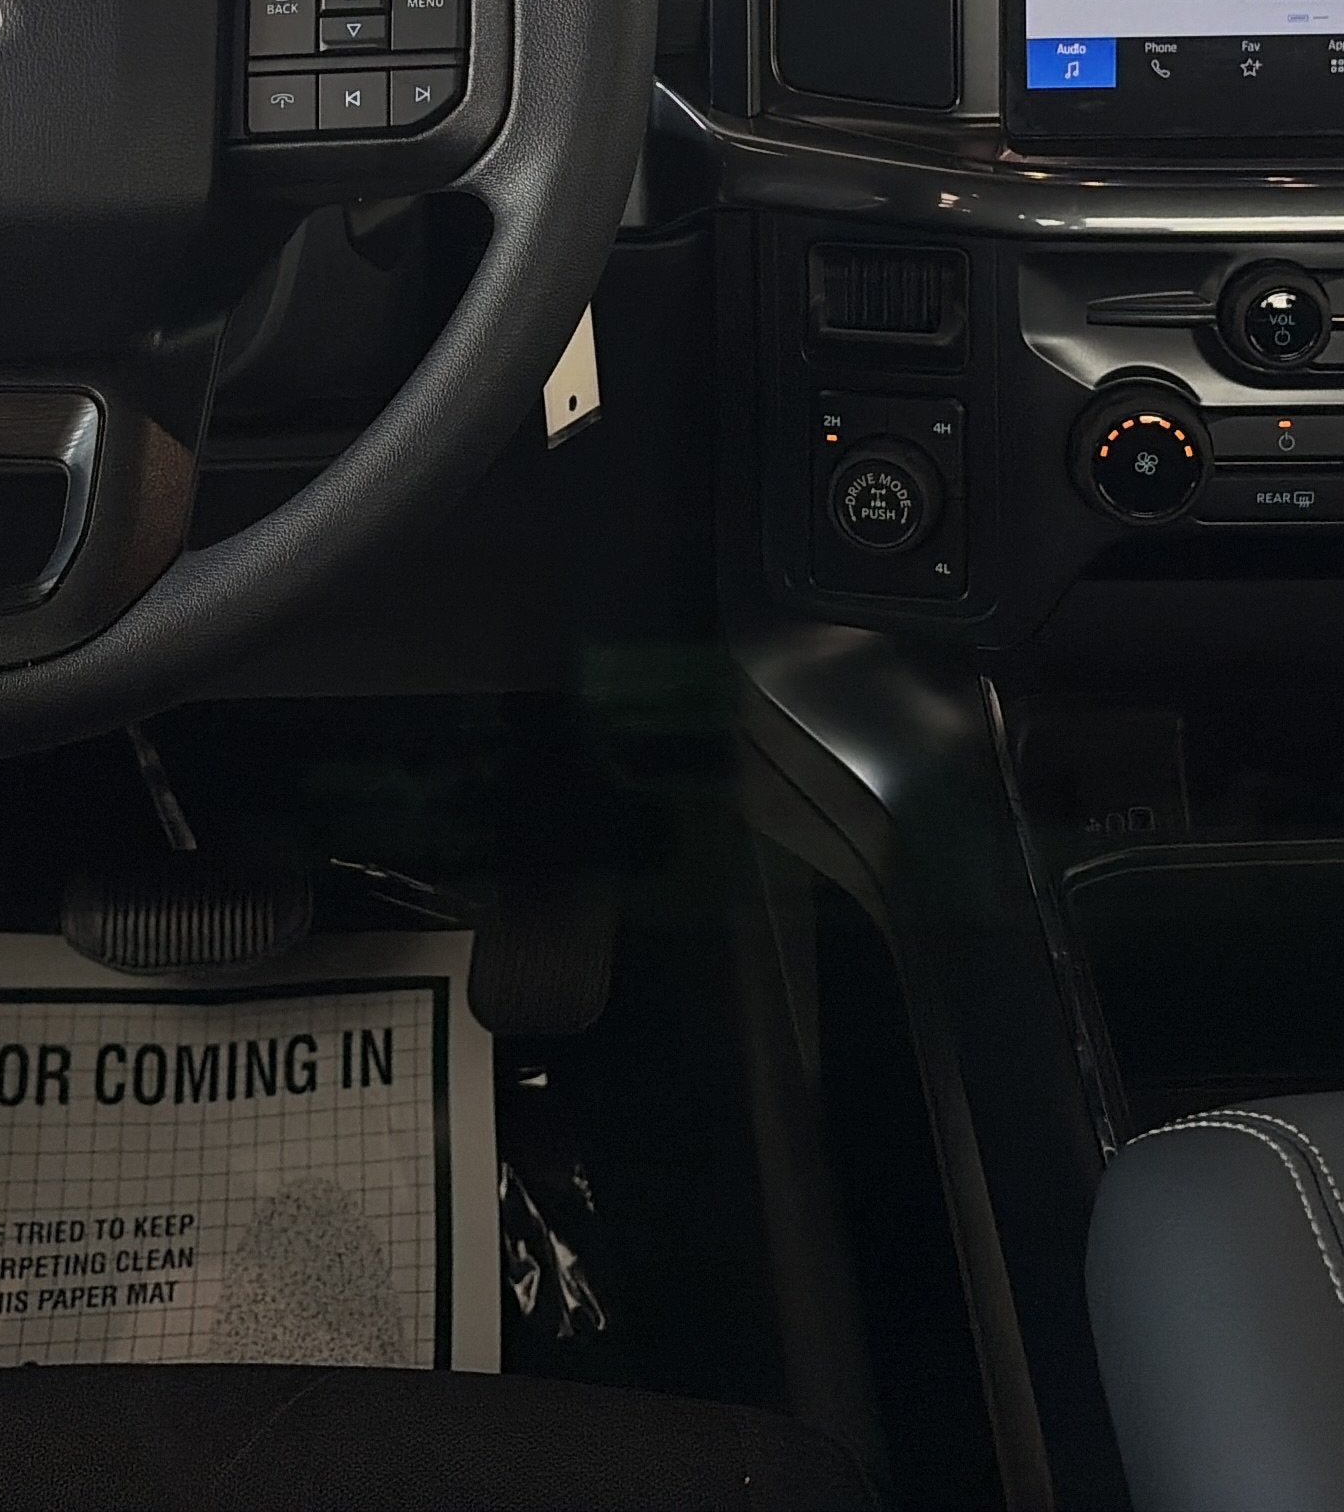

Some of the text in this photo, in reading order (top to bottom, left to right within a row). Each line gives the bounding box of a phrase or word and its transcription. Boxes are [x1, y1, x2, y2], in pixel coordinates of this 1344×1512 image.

[266, 4, 299, 15] BACK
[1056, 42, 1087, 56] Audio
[1144, 41, 1178, 55] Phone
[1241, 41, 1261, 54] Fav
[1269, 314, 1296, 326] VOL
[823, 415, 841, 427] 2H
[932, 423, 951, 434] 4H
[845, 473, 911, 507] DRIVE MODE
[1257, 493, 1291, 505] REAR
[861, 508, 896, 520] PUSH
[935, 563, 951, 574] 4L
[95, 1034, 318, 1106] COMING
[342, 1027, 394, 1089] IN
[13, 1220, 85, 1245] TRIED
[95, 1217, 126, 1240] TO
[134, 1213, 195, 1238] KEEP
[115, 1246, 194, 1273] CLEAN
[37, 1285, 118, 1311] PAPER
[126, 1280, 180, 1306] MAT
